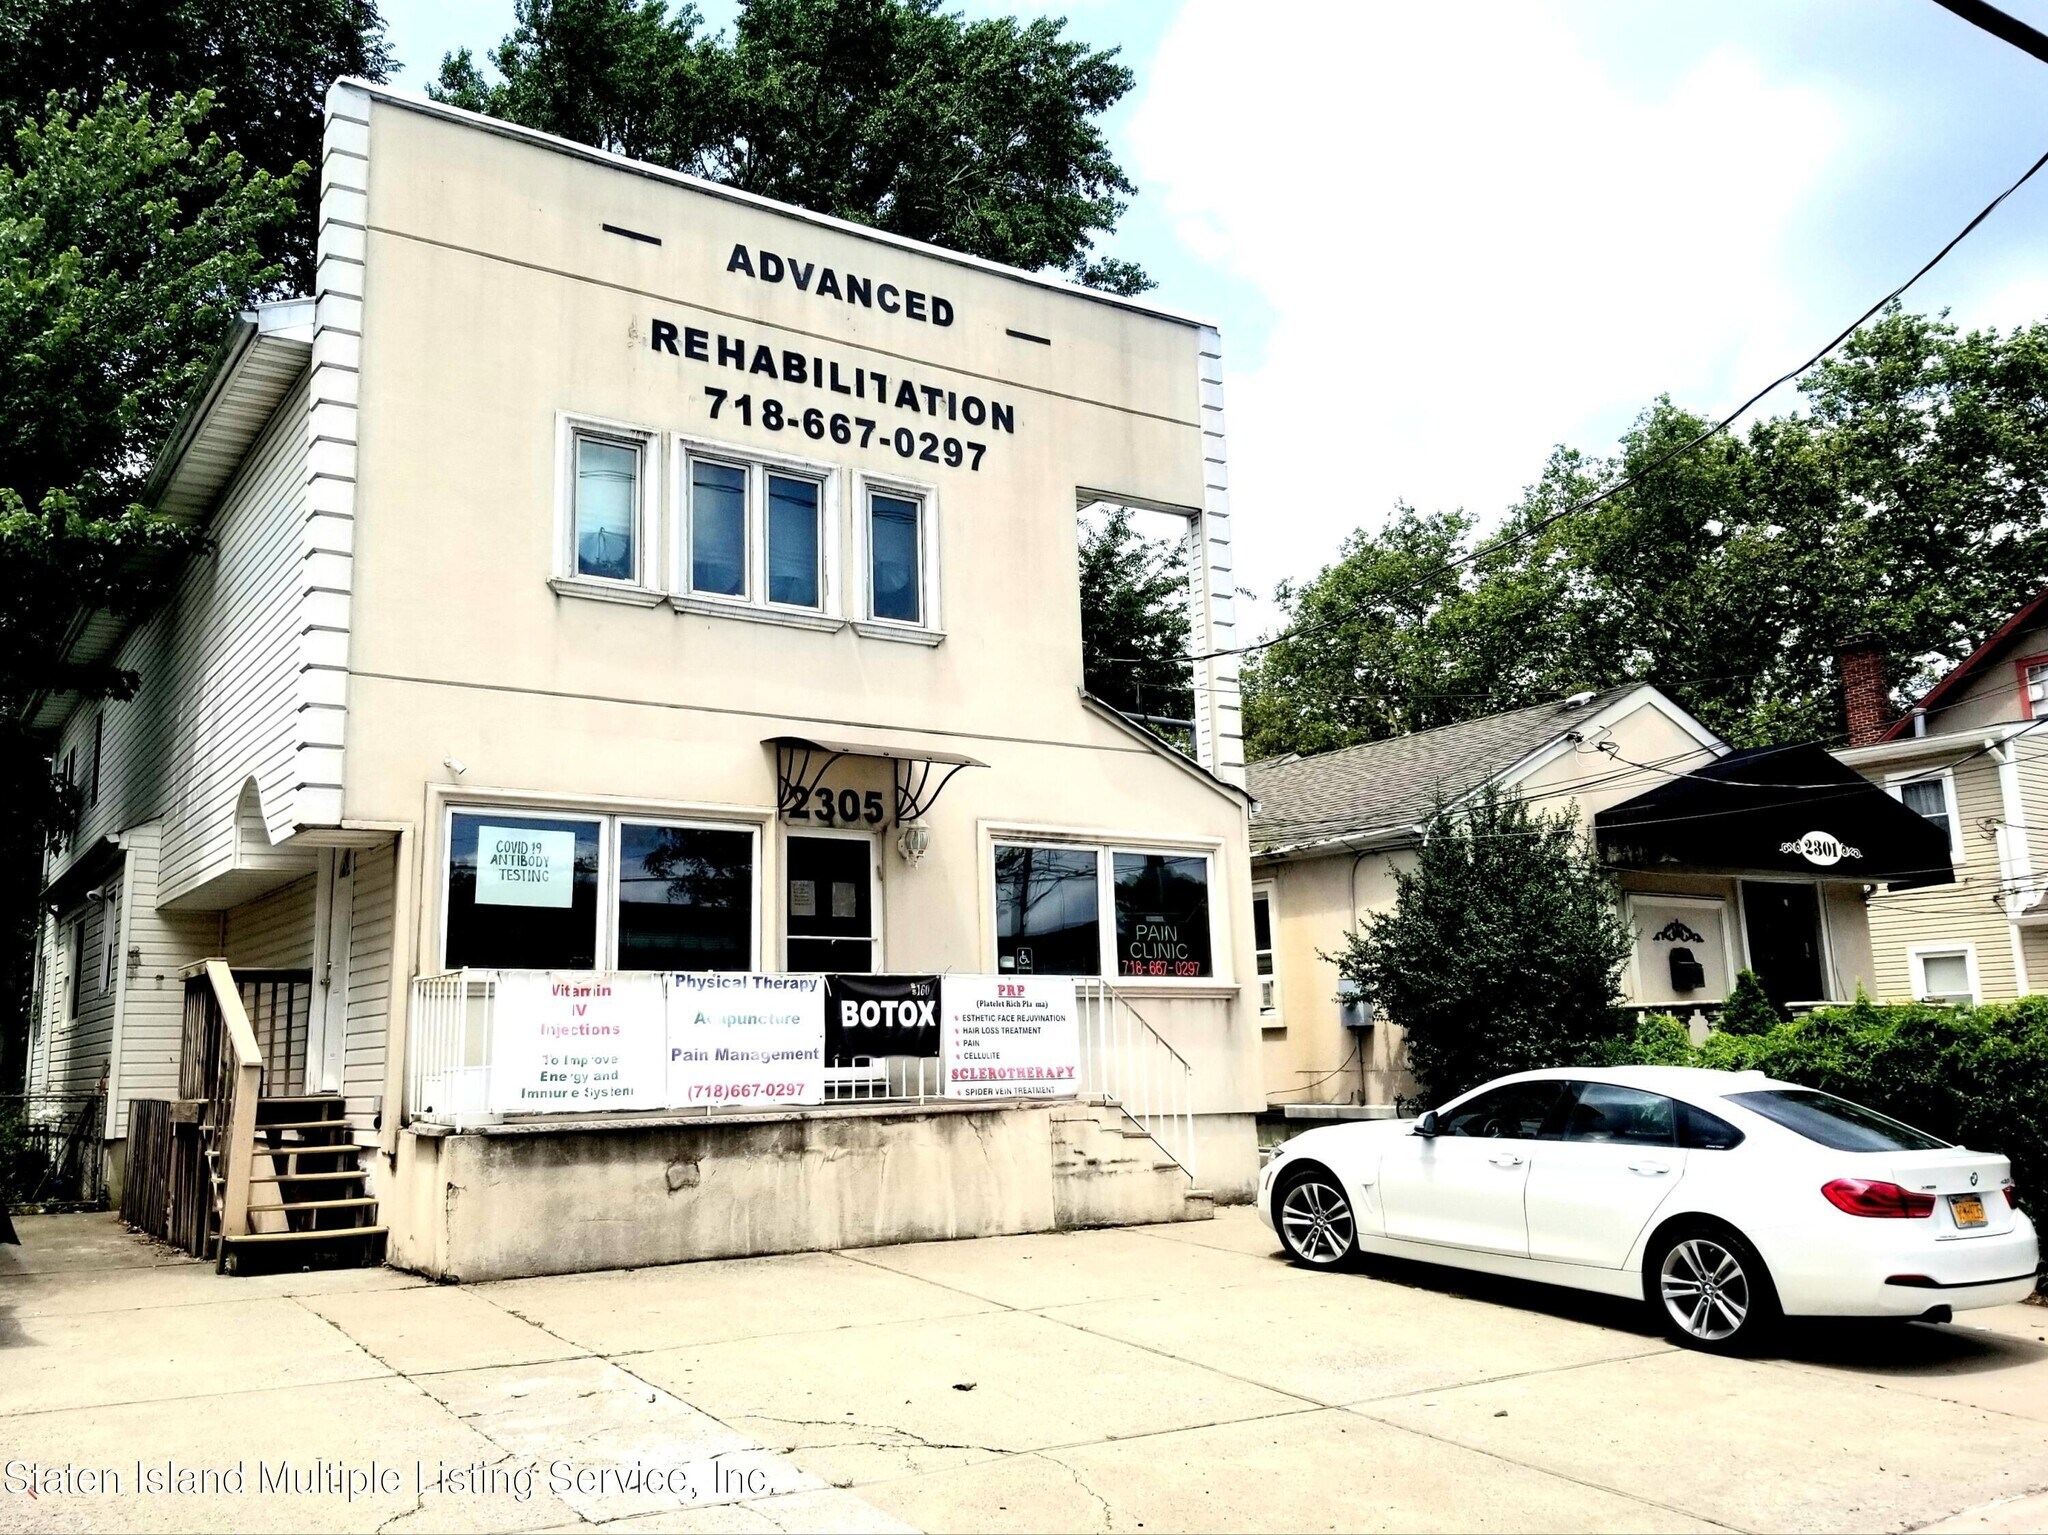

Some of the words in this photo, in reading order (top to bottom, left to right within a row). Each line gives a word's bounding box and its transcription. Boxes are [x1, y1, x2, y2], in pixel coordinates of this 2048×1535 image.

[727, 243, 954, 327] ADVANCED
[651, 319, 1014, 434] REHABILITATION
[704, 386, 987, 471] 718-667-0297
[789, 786, 884, 824] 2305
[496, 840, 528, 855] COVID
[531, 842, 542, 854] 19
[1804, 839, 1838, 857] 2301
[490, 854, 549, 868] ANTIBODY
[499, 868, 549, 882] TESTING
[1136, 924, 1177, 942] PAIN
[1130, 942, 1188, 960] CLINIC
[675, 974, 747, 991] Physical
[753, 976, 818, 992] Therapy
[997, 984, 1025, 996] PRP
[552, 984, 612, 997] Vitamin
[572, 1004, 587, 1016] IV
[976, 1000, 1004, 1009] (Platelet
[1006, 1000, 1021, 1008] Rich
[1022, 1000, 1048, 1009] Plama)
[841, 1000, 936, 1027] BOTOX
[962, 1014, 996, 1022] ESTHETIC
[998, 1014, 1015, 1022] FACE
[541, 1024, 620, 1038] Injections
[564, 1055, 618, 1067] Impove
[671, 1048, 708, 1061] Pain
[715, 1048, 819, 1064] Management
[964, 1052, 1000, 1060] CELLULITE
[540, 1071, 588, 1084] Enegy
[594, 1070, 618, 1081] and
[952, 1066, 1075, 1080] SCLEROTHERAPY
[688, 1083, 805, 1101] (718)667-0297
[965, 1088, 993, 1096] SPIDER
